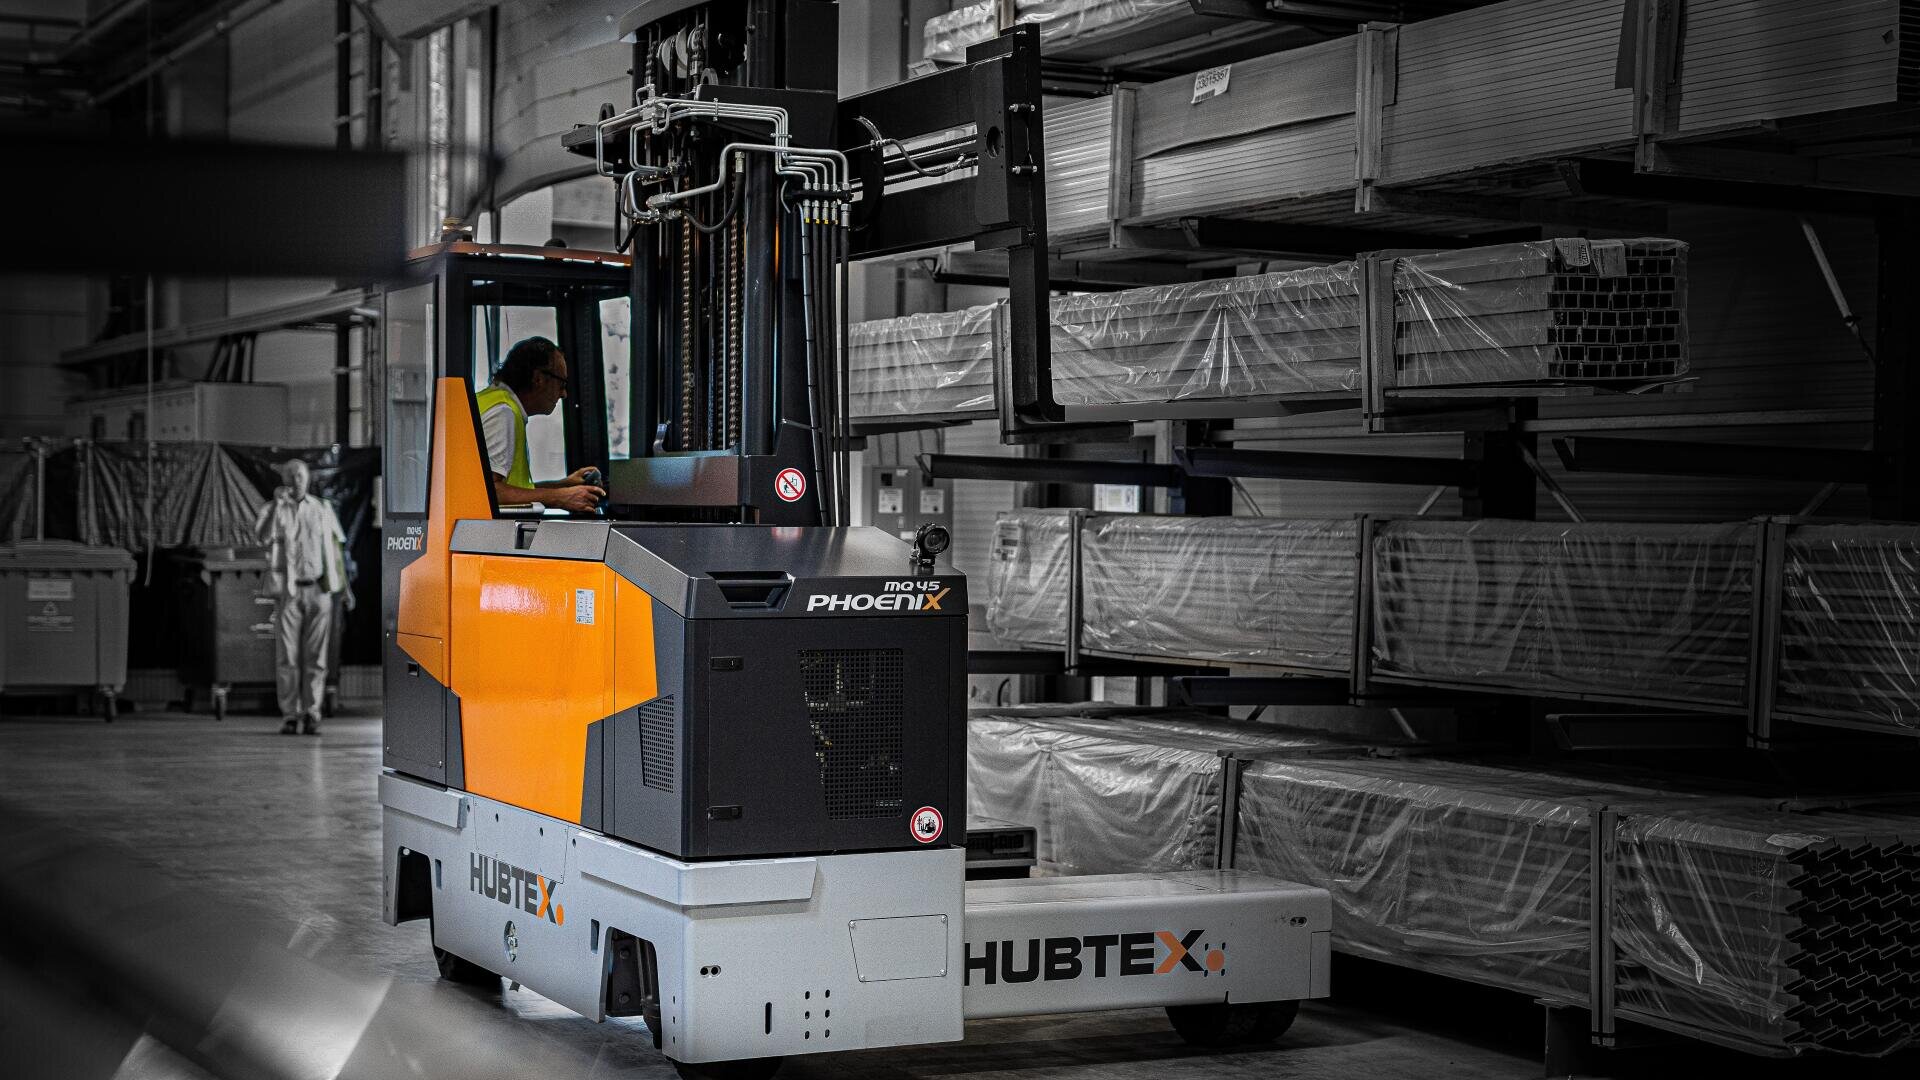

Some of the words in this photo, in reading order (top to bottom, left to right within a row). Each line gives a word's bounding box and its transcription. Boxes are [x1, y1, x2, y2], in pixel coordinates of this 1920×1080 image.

[387, 533, 425, 551] PHOENIX
[883, 580, 914, 592] MQ
[916, 580, 941, 592] 45
[806, 587, 951, 612] PHOENIX
